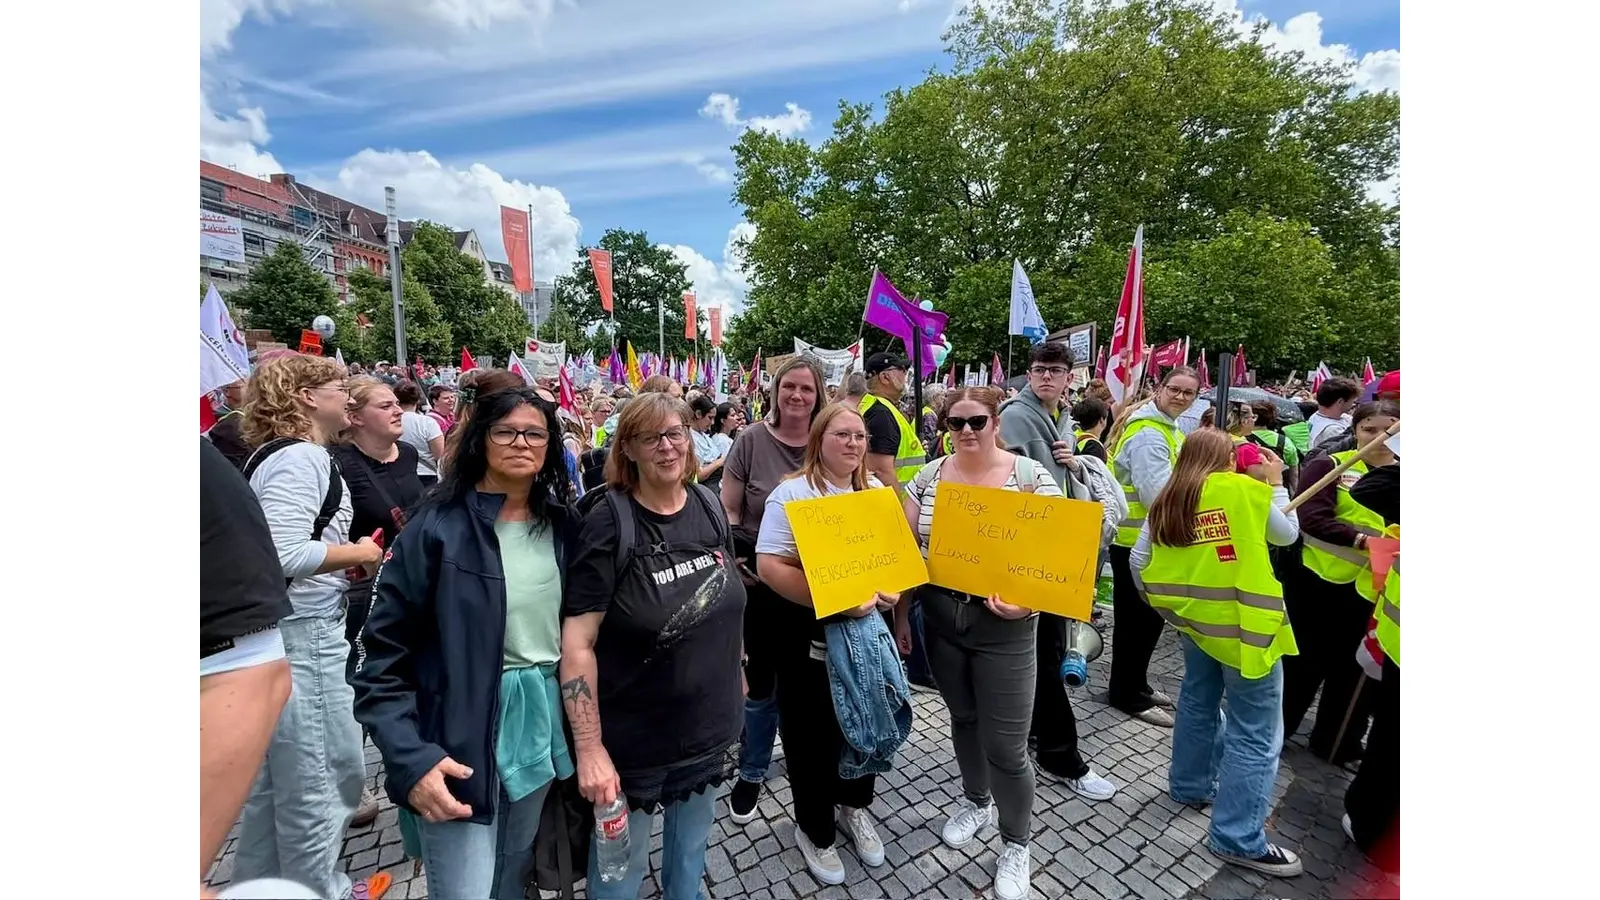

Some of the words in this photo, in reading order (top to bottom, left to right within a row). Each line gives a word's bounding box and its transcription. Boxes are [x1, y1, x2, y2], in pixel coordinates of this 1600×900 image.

[945, 488, 990, 517] Pflege
[1015, 500, 1054, 521] darf
[798, 506, 844, 537] Pflege
[977, 522, 1018, 541] KEIN
[934, 538, 981, 565] Luxus
[652, 568, 675, 585] YOU
[674, 560, 695, 579] ARE
[810, 552, 899, 586] MENSCHENWÜRDE
[1007, 561, 1068, 584] werden
